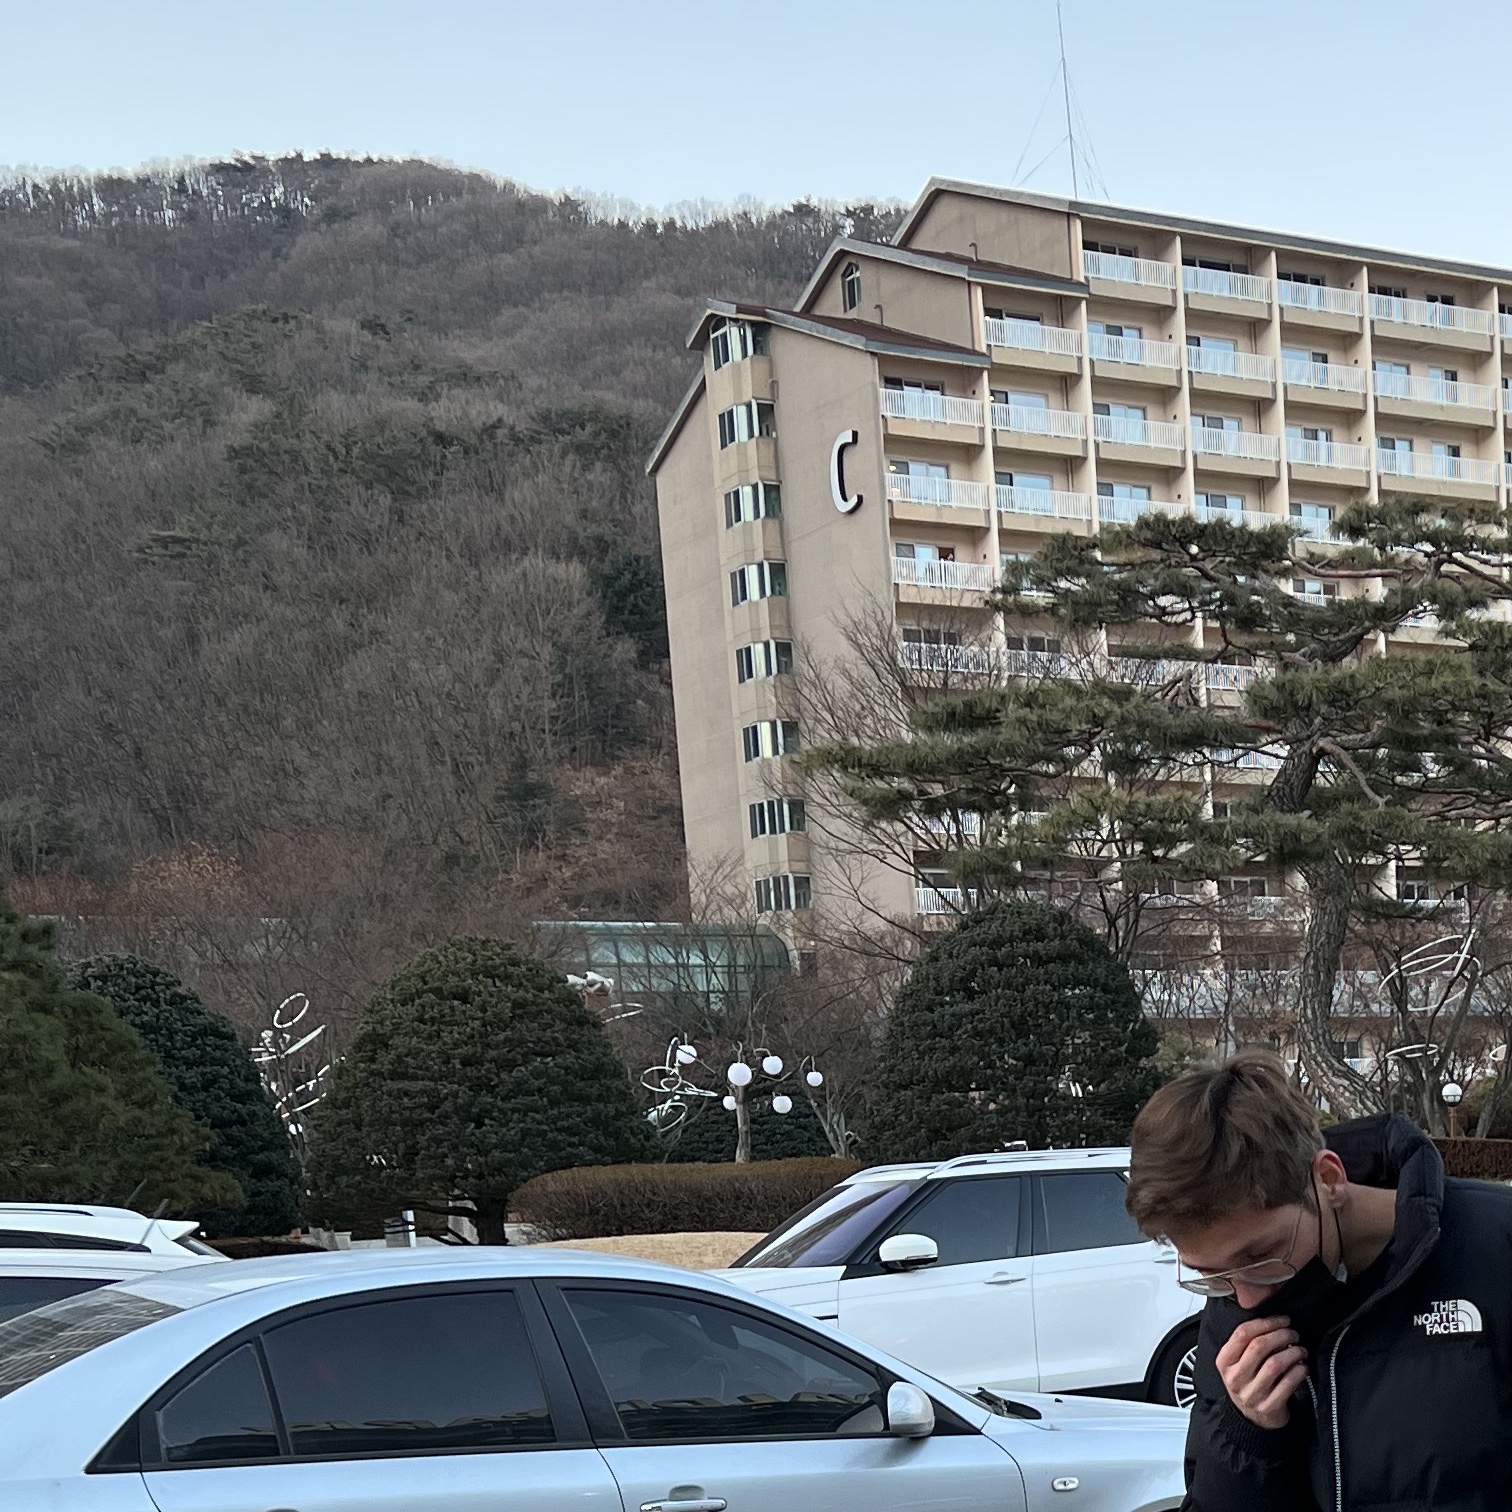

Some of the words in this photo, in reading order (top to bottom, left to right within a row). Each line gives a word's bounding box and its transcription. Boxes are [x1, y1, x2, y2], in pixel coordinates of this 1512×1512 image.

[829, 429, 862, 514] C
[1431, 1299, 1457, 1313] THE
[1413, 1310, 1458, 1327] NORTH
[1425, 1321, 1459, 1336] FACE
